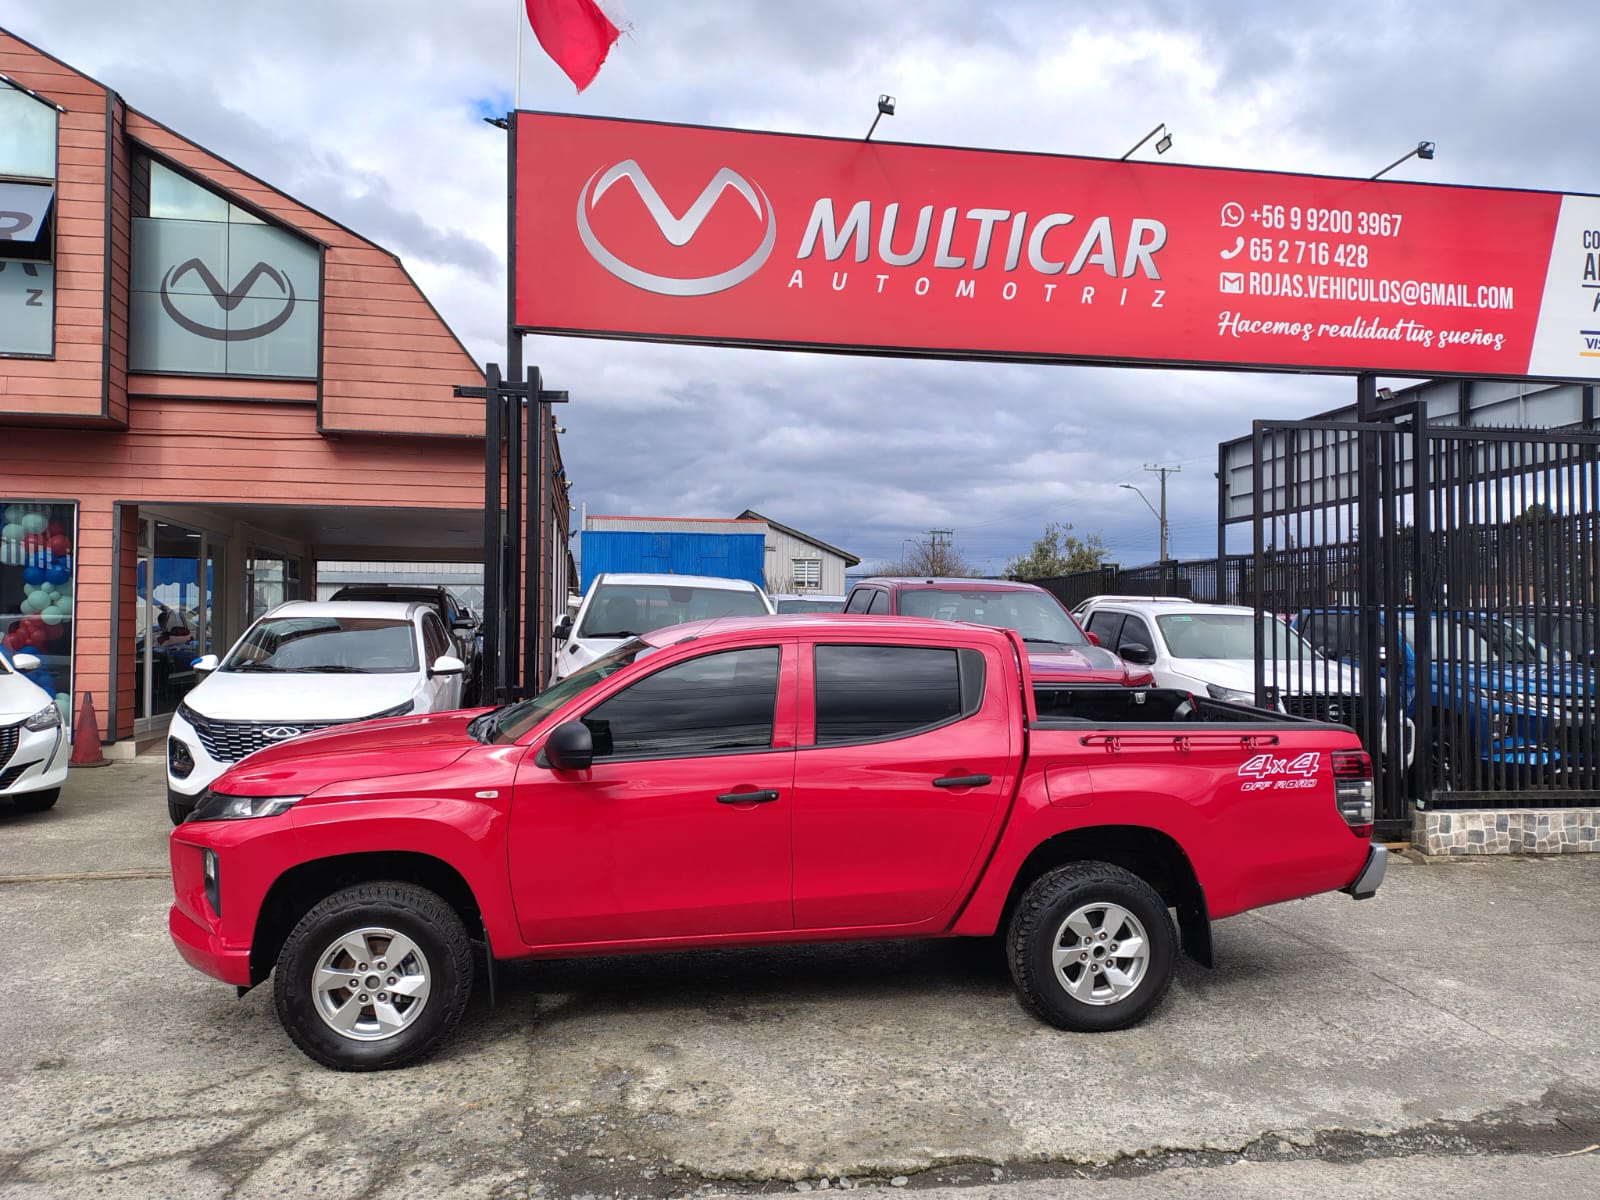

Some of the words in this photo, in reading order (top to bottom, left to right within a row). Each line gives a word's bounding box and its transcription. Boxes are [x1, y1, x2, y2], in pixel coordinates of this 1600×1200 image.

[797, 197, 1167, 280] MULTICAR
[1250, 204, 1285, 229] +56
[1289, 206, 1301, 231] 9
[1306, 208, 1353, 234] 9200
[1357, 211, 1403, 238] 3967
[1249, 237, 1273, 262] 65
[1278, 239, 1289, 264] 2
[1294, 240, 1329, 266] 716
[1334, 243, 1369, 268] 428
[788, 268, 1166, 309] AUTOMOTRIZ
[1249, 271, 1514, 310] ROJAS.VEHICULOS@GMAIL.COM
[1217, 311, 1315, 341] Hacemos
[1317, 316, 1403, 342] realidad
[1404, 319, 1436, 348] tus
[1438, 328, 1507, 351] sueños
[1238, 752, 1320, 779] 4x4
[1241, 781, 1273, 792] OFF
[1273, 779, 1318, 790] ROAD
